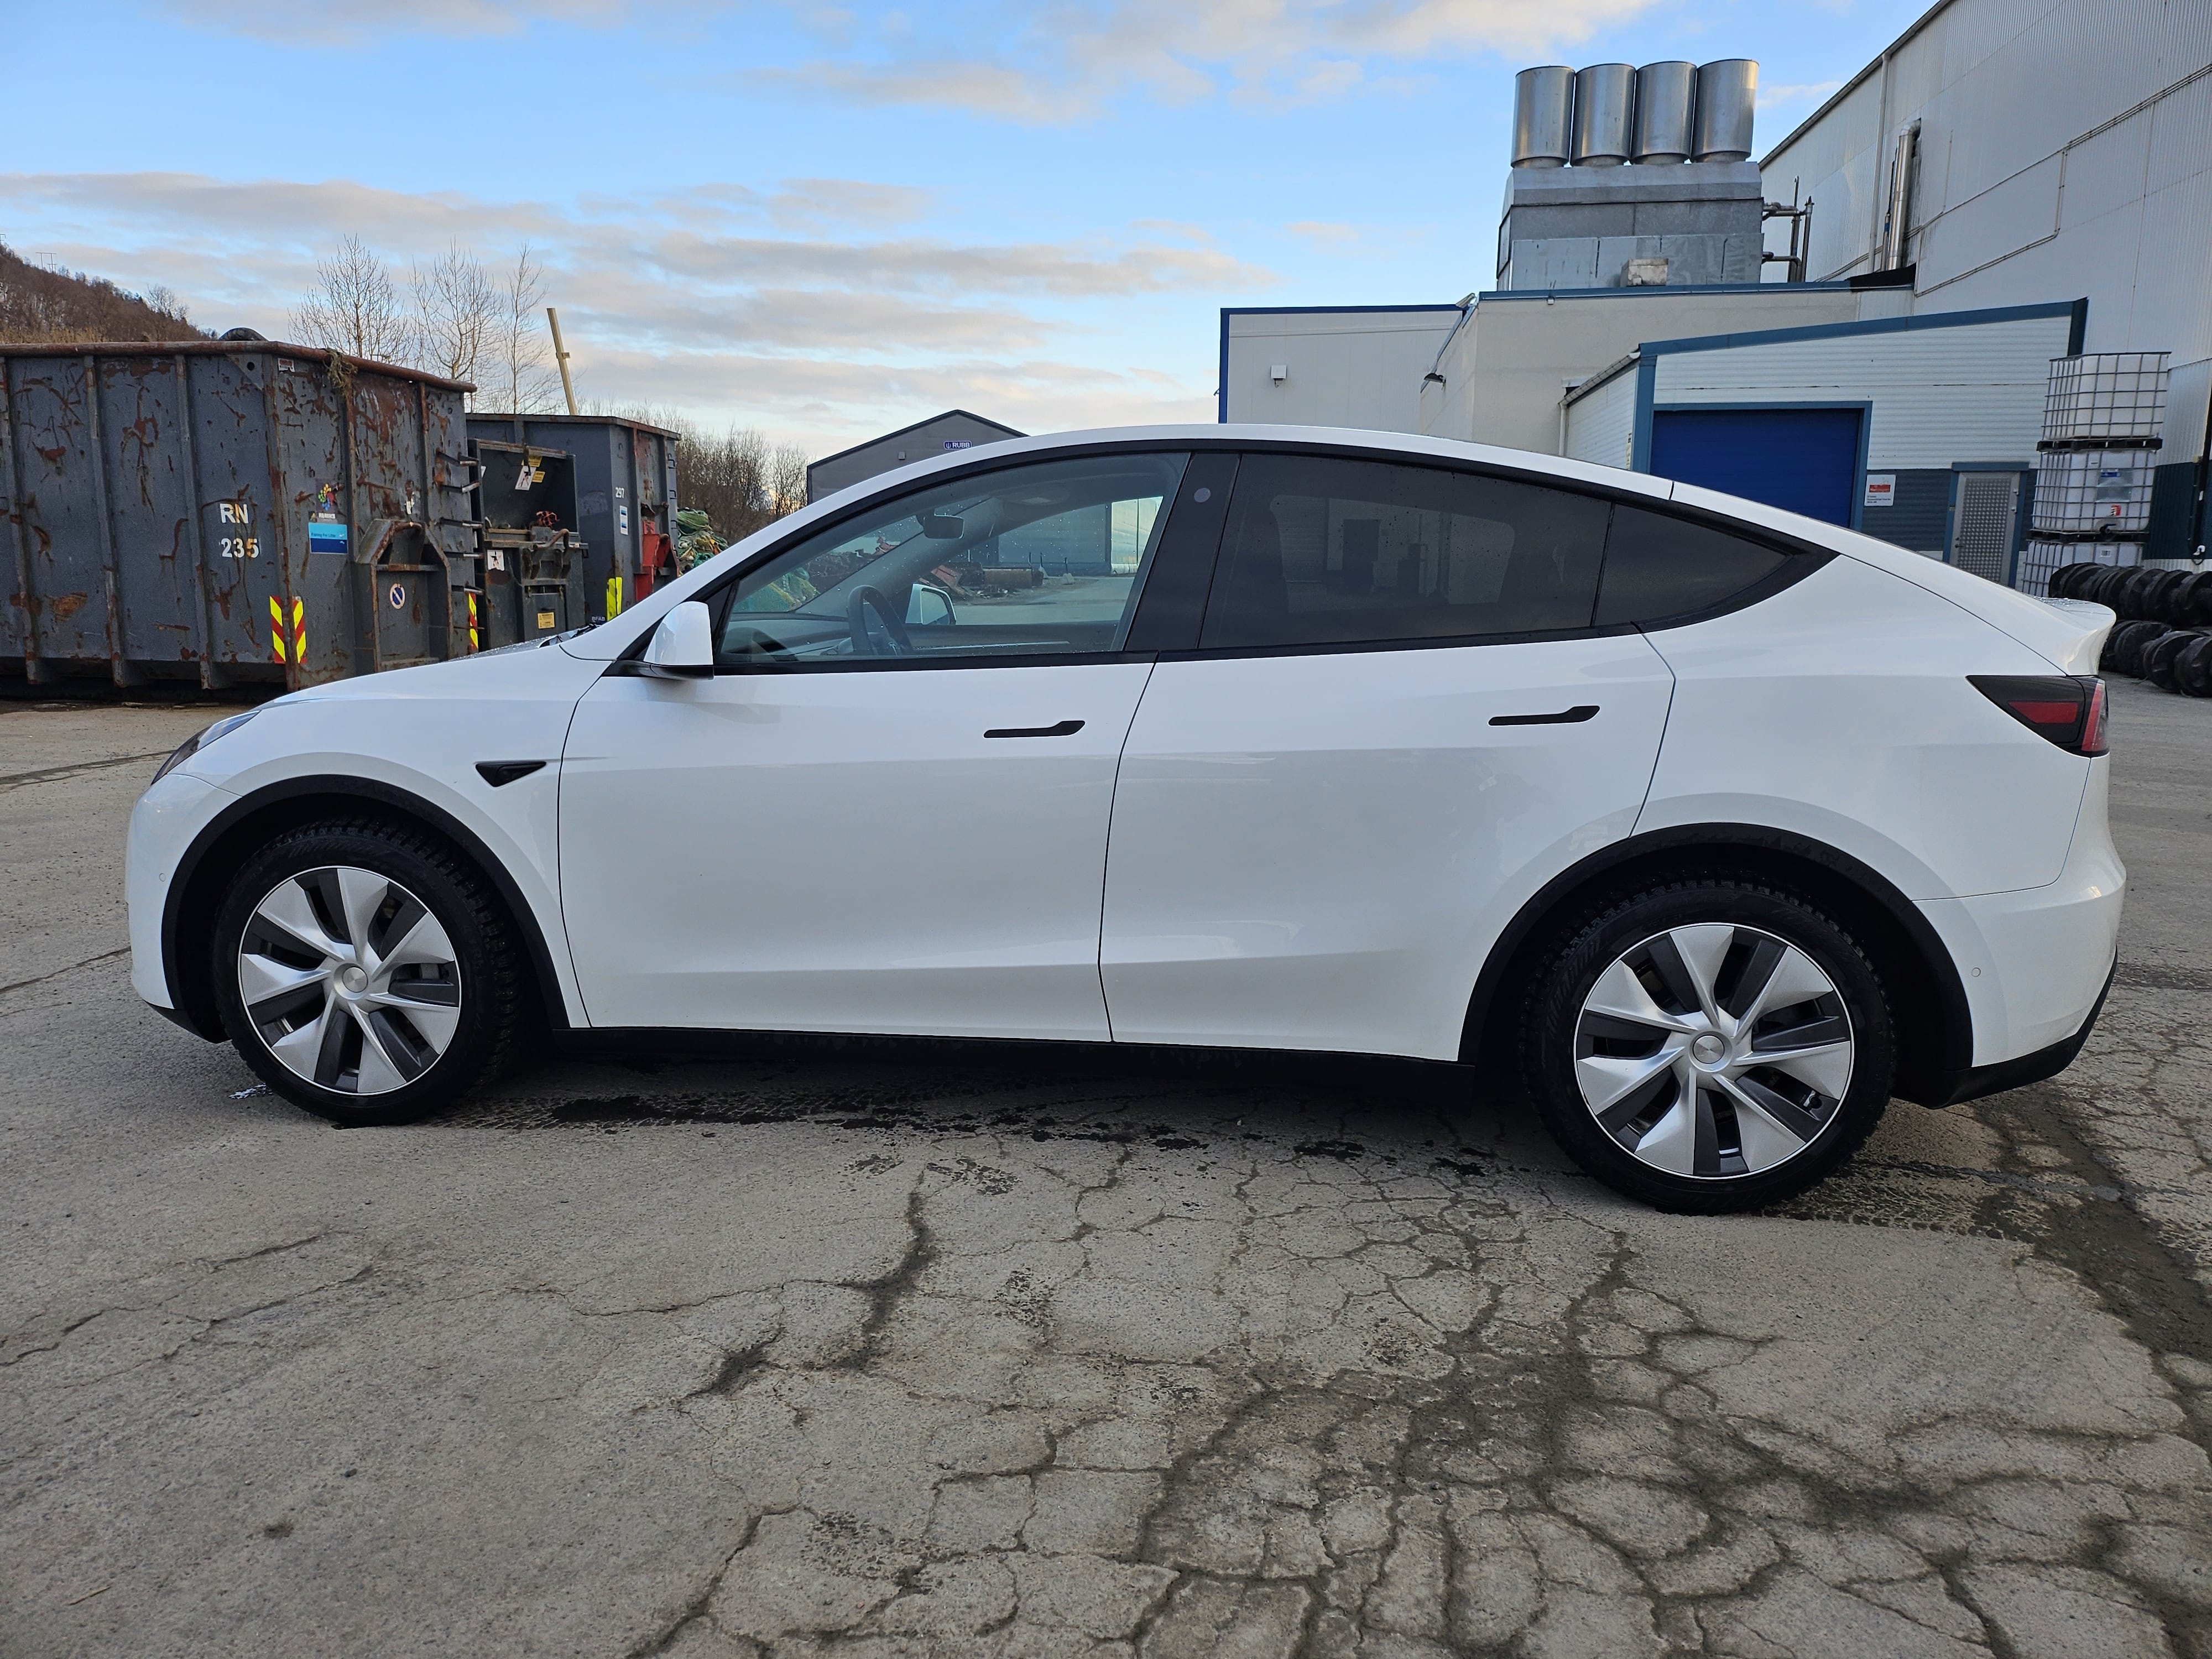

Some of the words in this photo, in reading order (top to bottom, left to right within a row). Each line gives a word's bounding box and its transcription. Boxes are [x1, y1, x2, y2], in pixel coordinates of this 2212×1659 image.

[615, 487, 624, 498] 297
[220, 503, 248, 523] RN
[221, 538, 259, 558] 235
